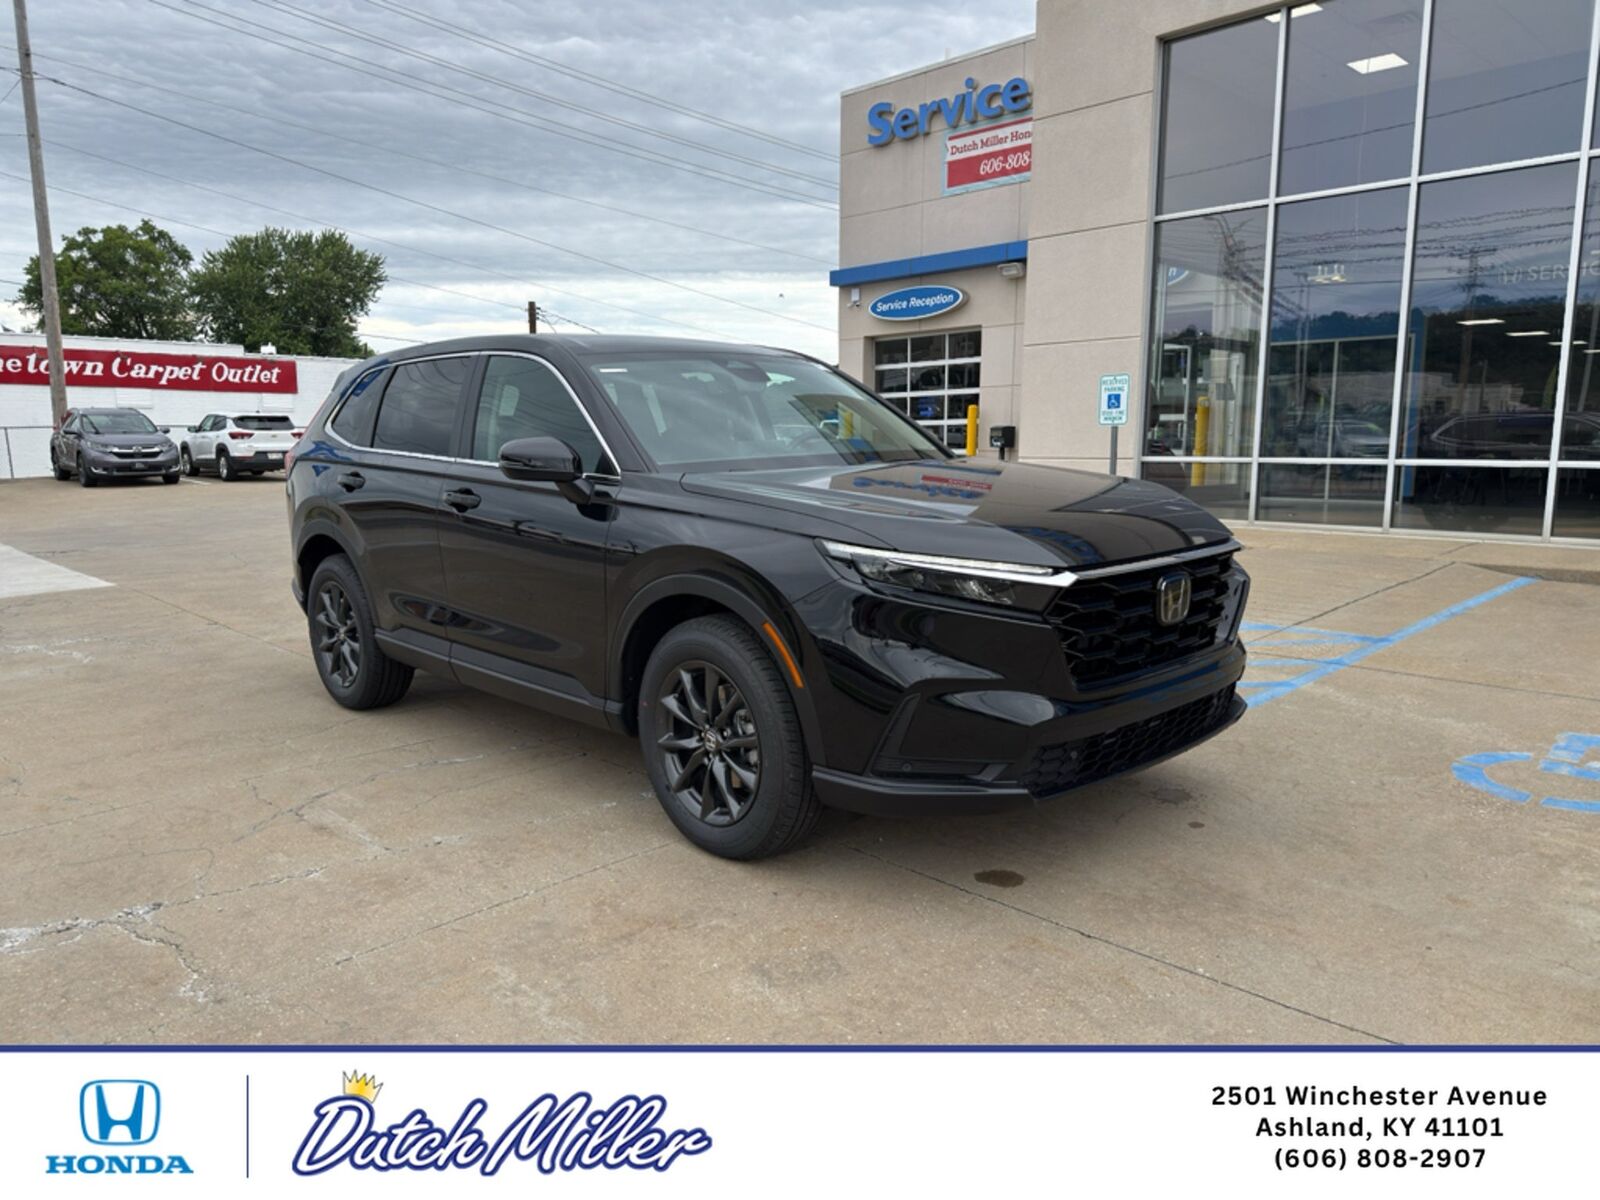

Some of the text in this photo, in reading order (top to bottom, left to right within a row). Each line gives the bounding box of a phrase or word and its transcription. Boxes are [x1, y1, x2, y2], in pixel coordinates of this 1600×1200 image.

[867, 77, 1030, 146] Service
[950, 129, 1033, 156] Dutch Miller Hon
[876, 293, 954, 312] Service Reception
[111, 357, 206, 385] Carpet
[211, 361, 281, 384] Outlet
